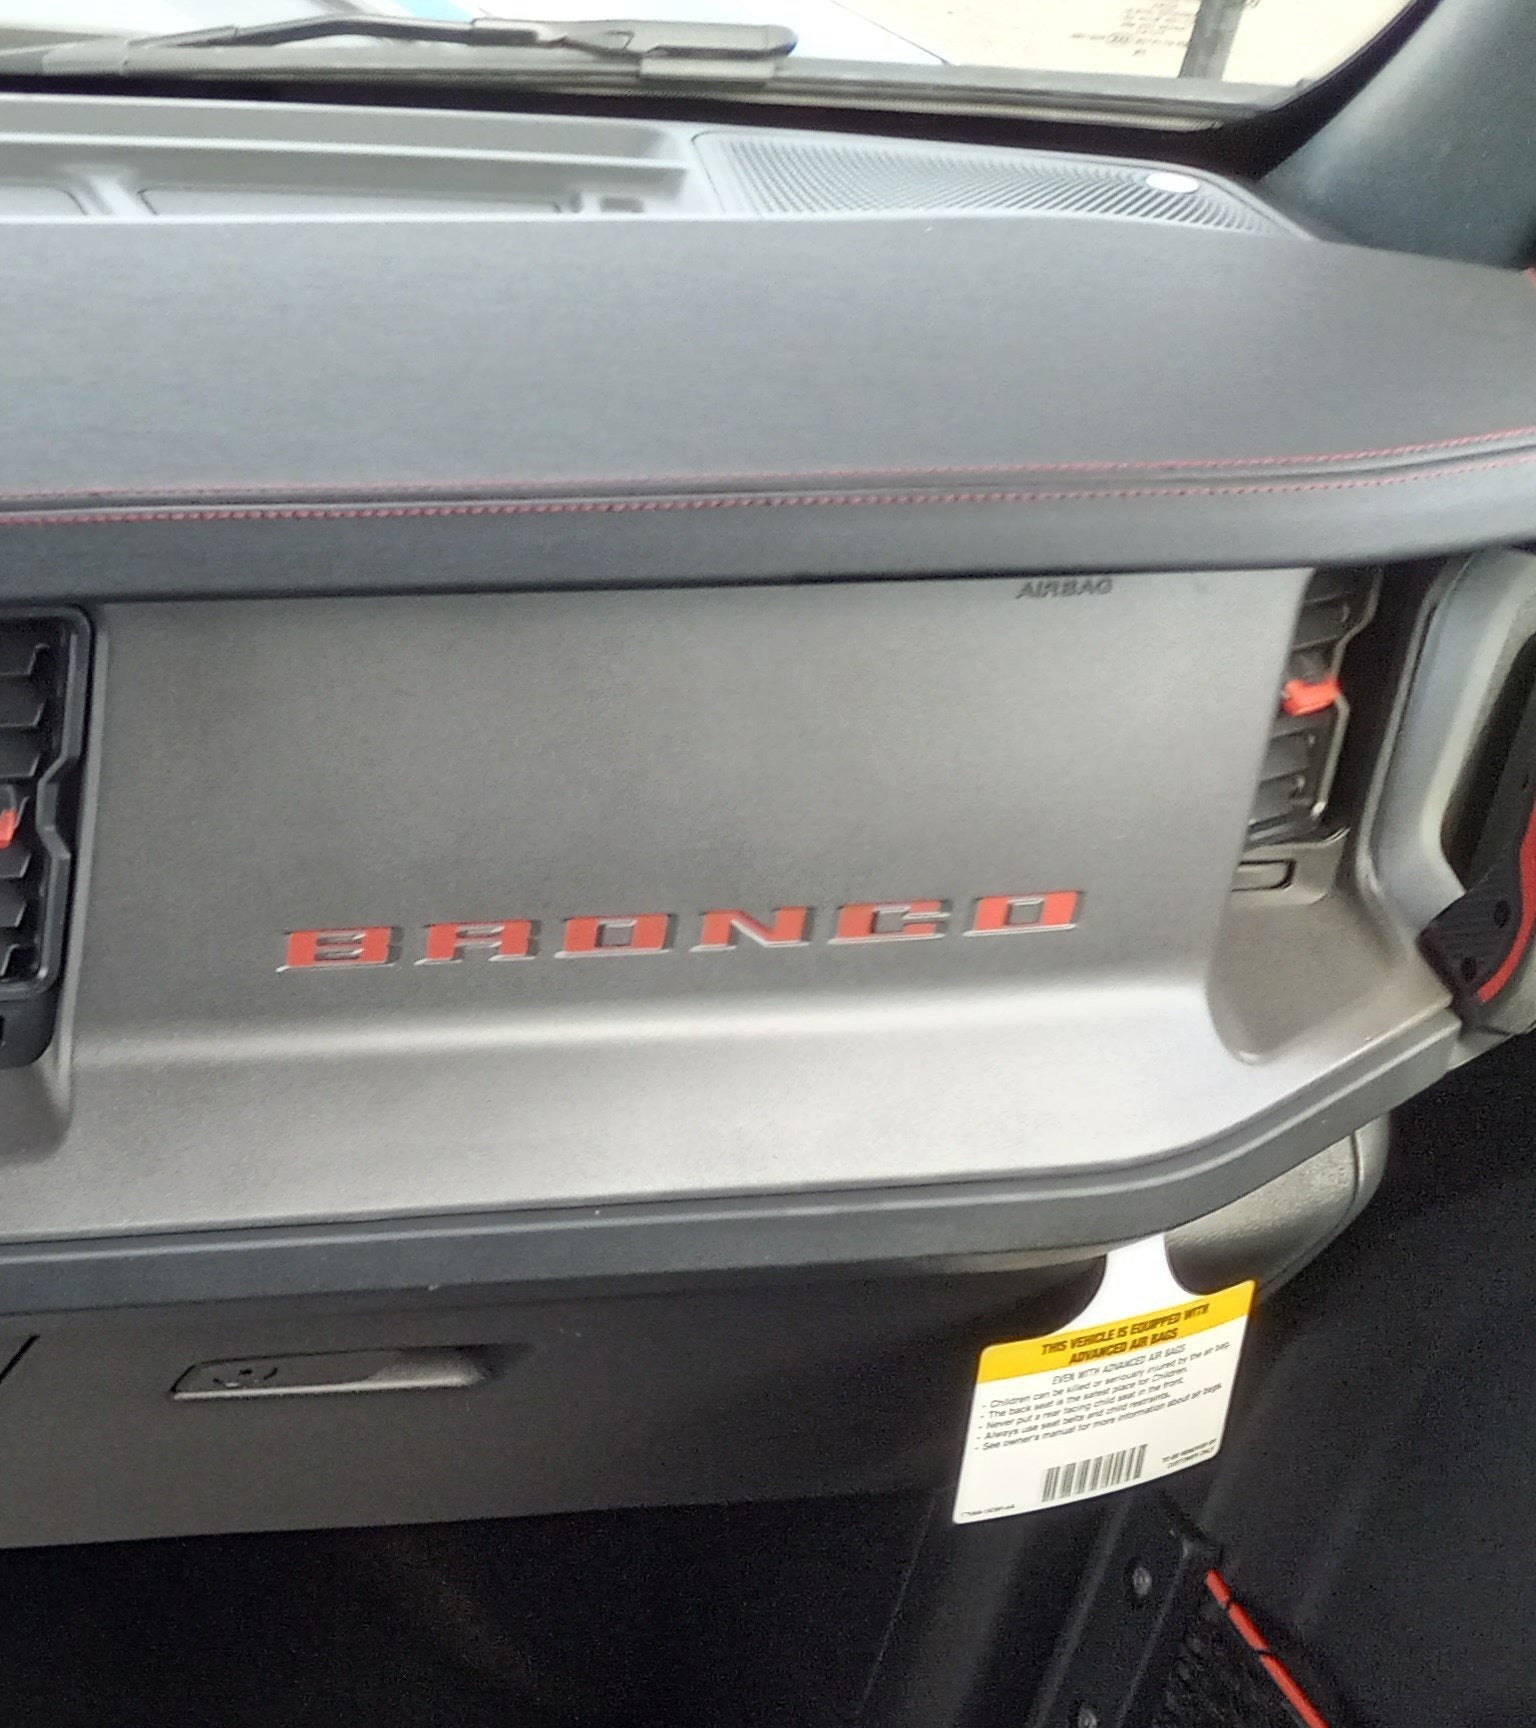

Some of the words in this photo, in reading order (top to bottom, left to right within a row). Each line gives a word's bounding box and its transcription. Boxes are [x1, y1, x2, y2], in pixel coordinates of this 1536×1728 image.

[1015, 577, 1114, 600] AIRBAG
[276, 889, 1083, 973] BRONCO
[1041, 1340, 1067, 1354] THIS
[1070, 1329, 1114, 1348] VEHICLE
[1116, 1326, 1128, 1337] IS
[1130, 1313, 1180, 1333] EQUIPPED
[1184, 1304, 1208, 1319] WITH
[1070, 1341, 1126, 1363] ADVANCED
[1129, 1336, 1148, 1349] AIR
[1150, 1328, 1177, 1343] BAGS
[1052, 1372, 1074, 1384] EVEN
[1103, 1356, 1144, 1372] ADVANCED
[986, 1416, 1014, 1429] Never
[1063, 1402, 1090, 1415] facing
[1094, 1397, 1114, 1406] child
[988, 1408, 1006, 1418] The
[1009, 1404, 1030, 1415] back
[1034, 1401, 1052, 1410] seat
[1084, 1389, 1109, 1398] safest
[990, 1392, 1030, 1409] Children
[982, 1439, 1001, 1449] See
[1003, 1433, 1039, 1447] owner's
[1042, 1426, 1074, 1438] manual
[1093, 1417, 1114, 1426] more
[984, 1425, 1019, 1442] Always
[1041, 1420, 1059, 1428] seat
[1063, 1414, 1084, 1424] belts
[1107, 1404, 1126, 1413] child
